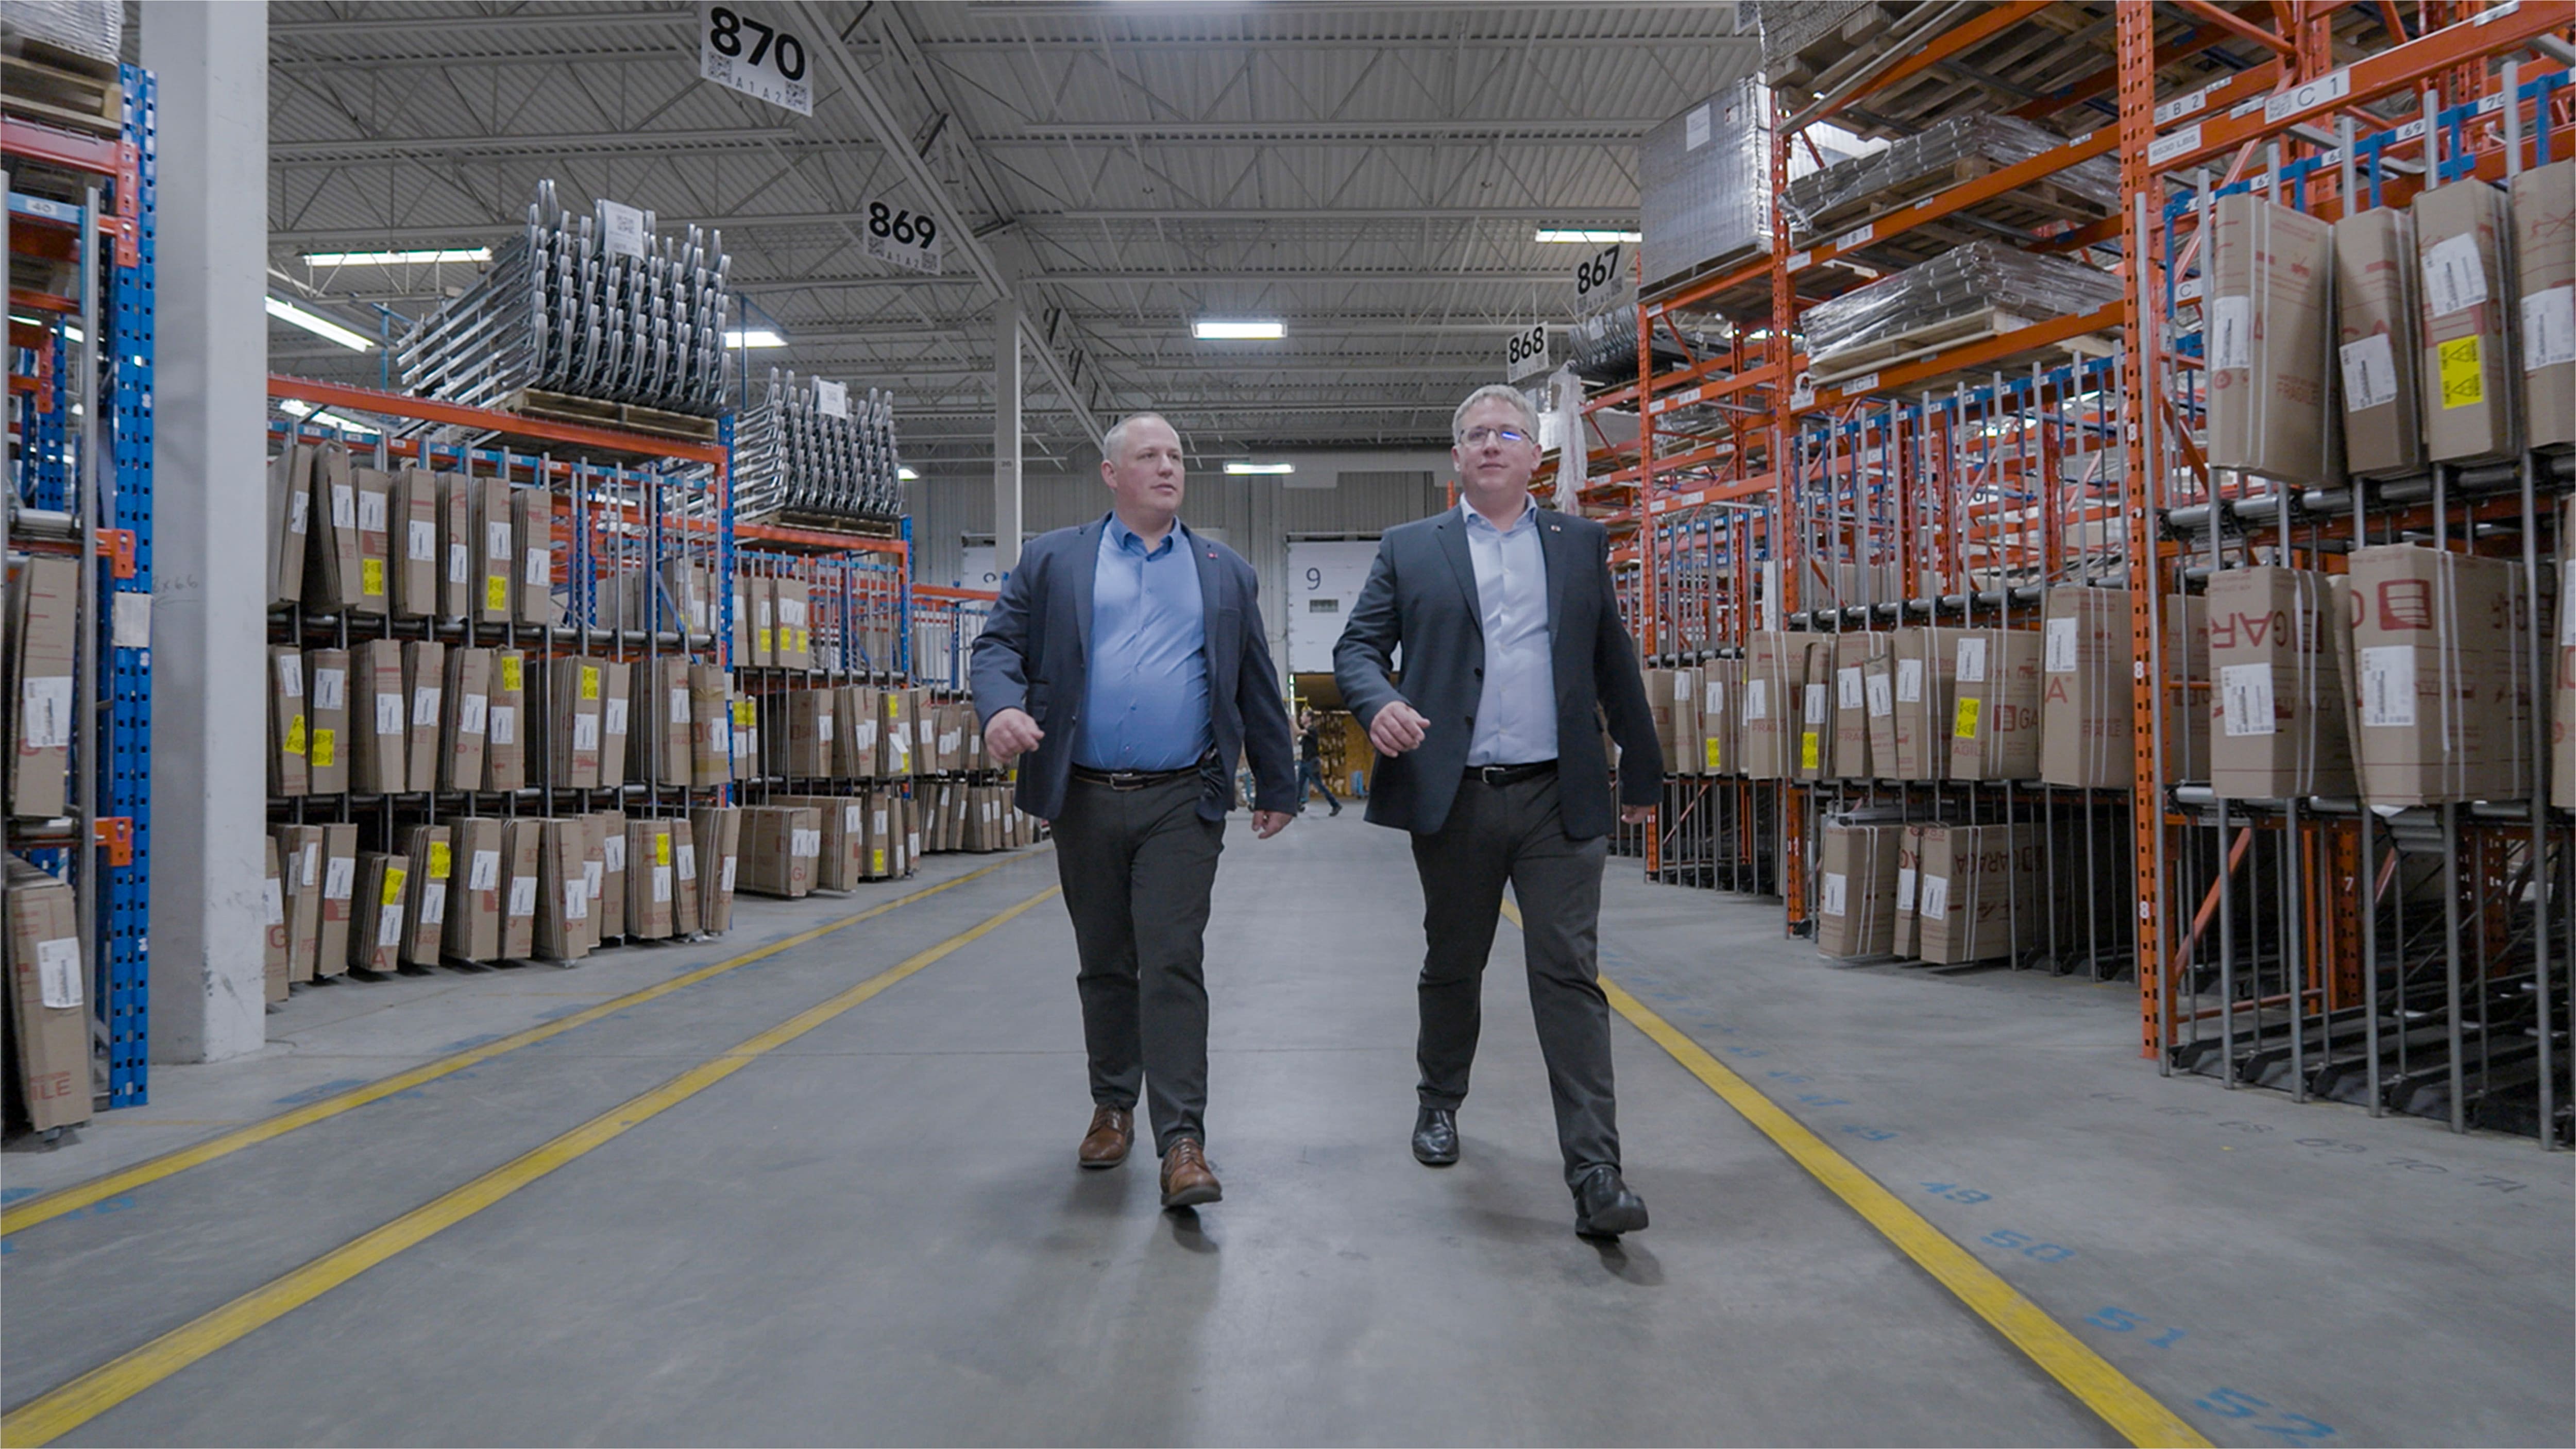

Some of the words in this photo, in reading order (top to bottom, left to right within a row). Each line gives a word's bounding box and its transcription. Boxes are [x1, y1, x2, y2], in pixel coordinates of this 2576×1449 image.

[710, 7, 805, 81] 870
[2173, 102, 2181, 115] B
[2192, 95, 2199, 108] 2
[2297, 87, 2315, 107] C
[2330, 78, 2337, 95] 1
[2404, 122, 2422, 136] 69
[869, 201, 936, 250] 869
[1577, 244, 1620, 295] 867
[2179, 283, 2192, 298] C
[1509, 326, 1544, 364] 868
[1306, 567, 1321, 590] 9
[2134, 661, 2144, 679] 8
[2344, 876, 2354, 892] 7
[2139, 901, 2150, 919] 8
[1980, 1229, 2076, 1263] 50
[2084, 1306, 2187, 1349] 51
[2193, 1386, 2337, 1448] 52
